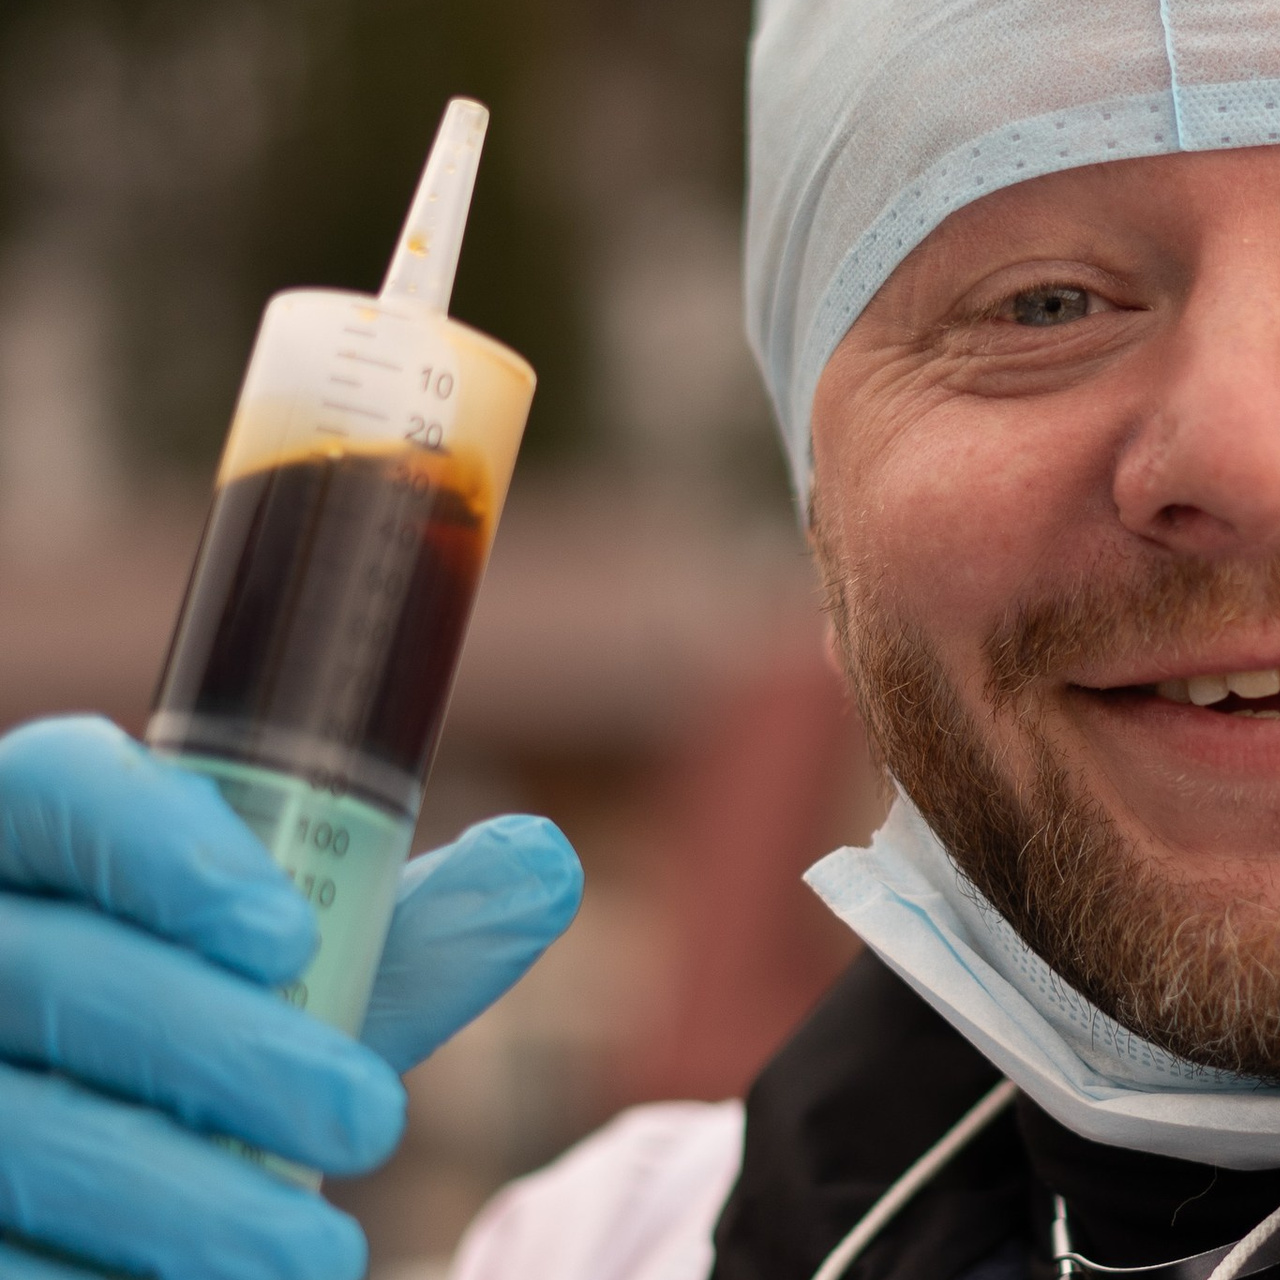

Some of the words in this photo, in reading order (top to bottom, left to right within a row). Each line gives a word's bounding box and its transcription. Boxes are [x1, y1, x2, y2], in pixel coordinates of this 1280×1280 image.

[421, 365, 455, 401] 10
[404, 414, 444, 450] 20
[299, 817, 350, 858] 100
[289, 870, 337, 909] 10
